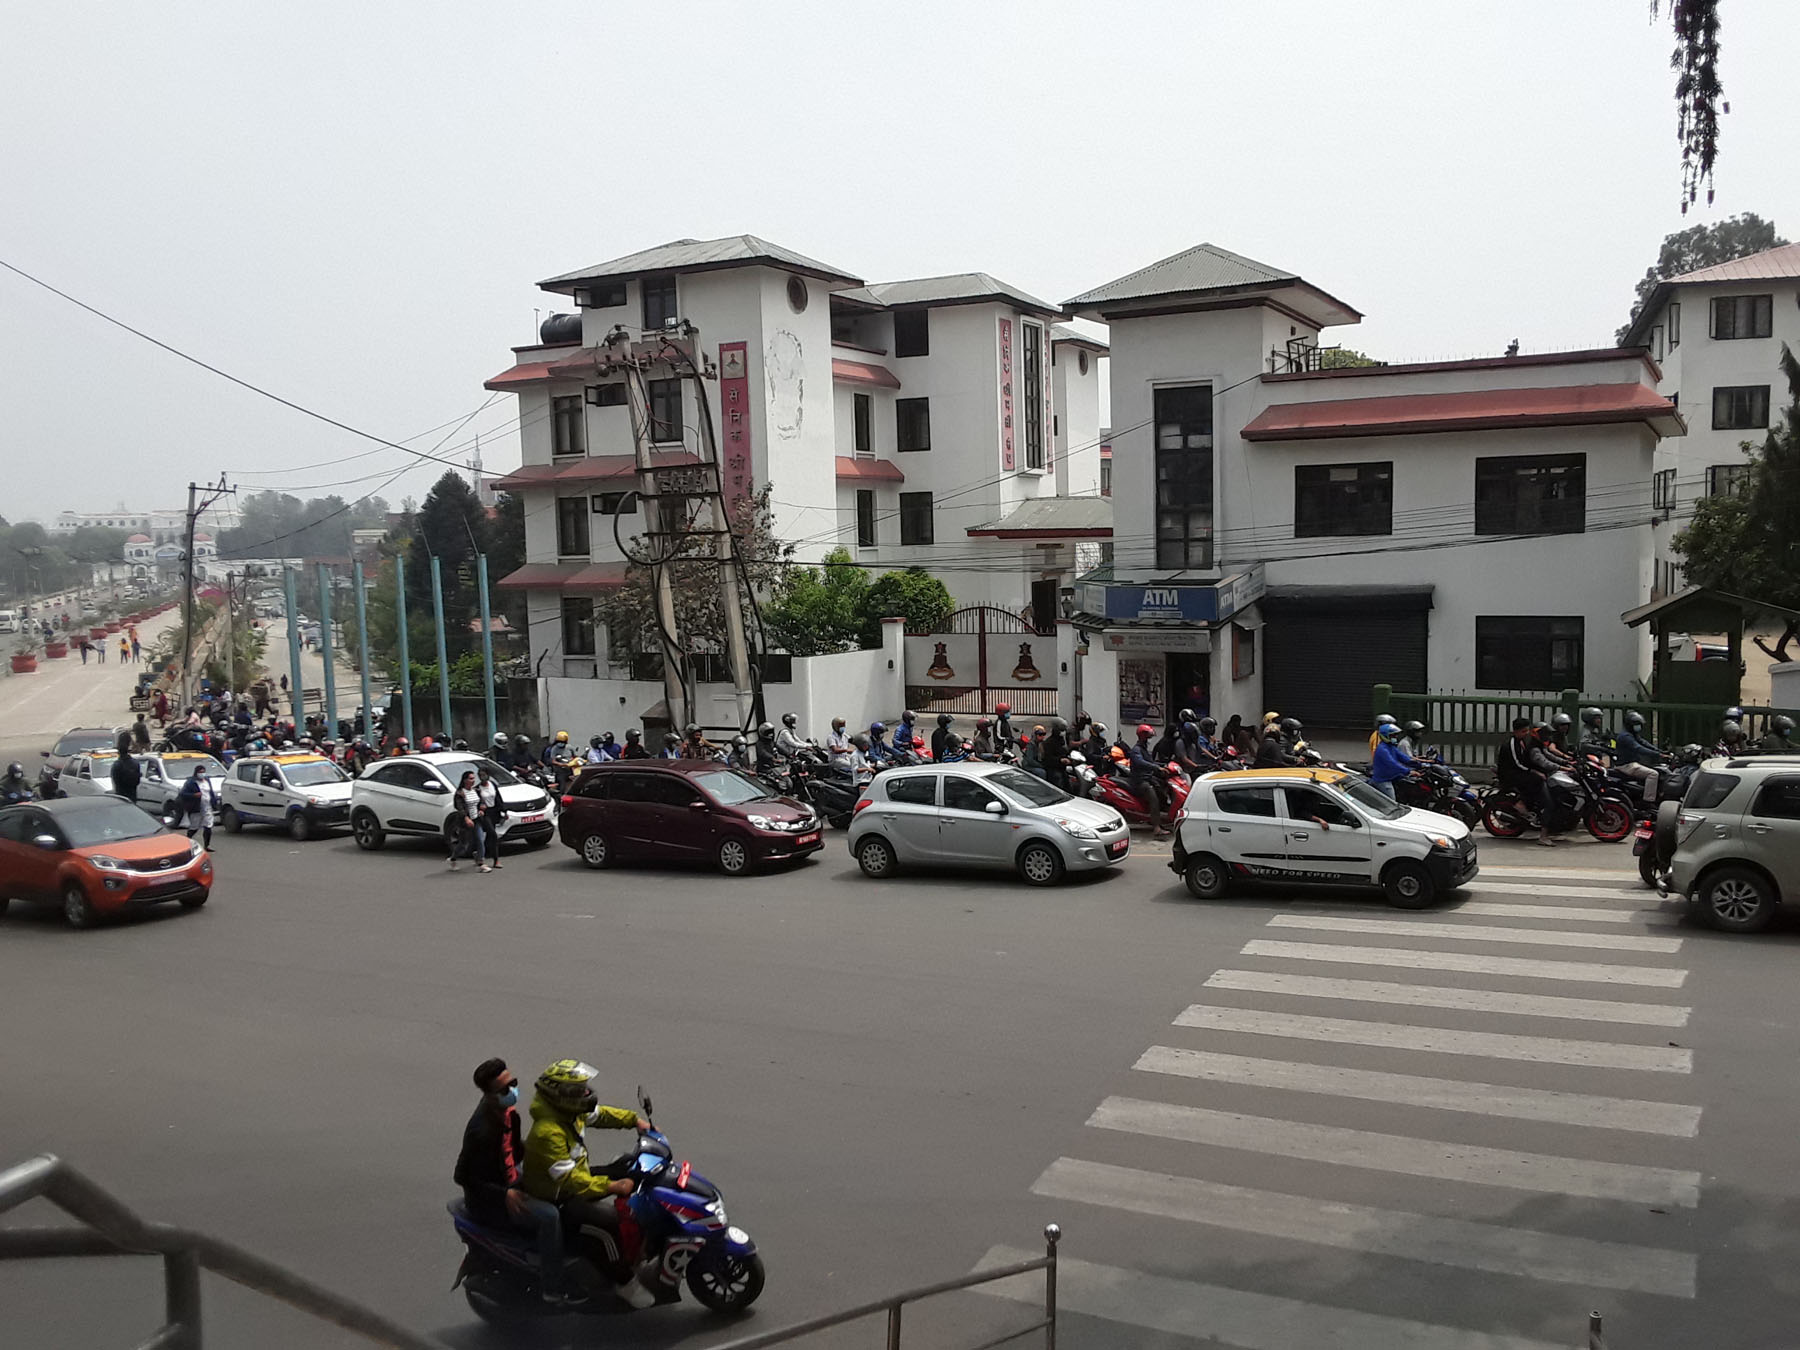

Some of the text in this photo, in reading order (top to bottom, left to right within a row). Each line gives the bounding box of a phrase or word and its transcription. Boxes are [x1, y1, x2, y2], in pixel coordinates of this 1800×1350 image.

[1143, 589, 1178, 605] ATM
[1251, 868, 1279, 876] NEED
[1306, 871, 1341, 879] SPEED
